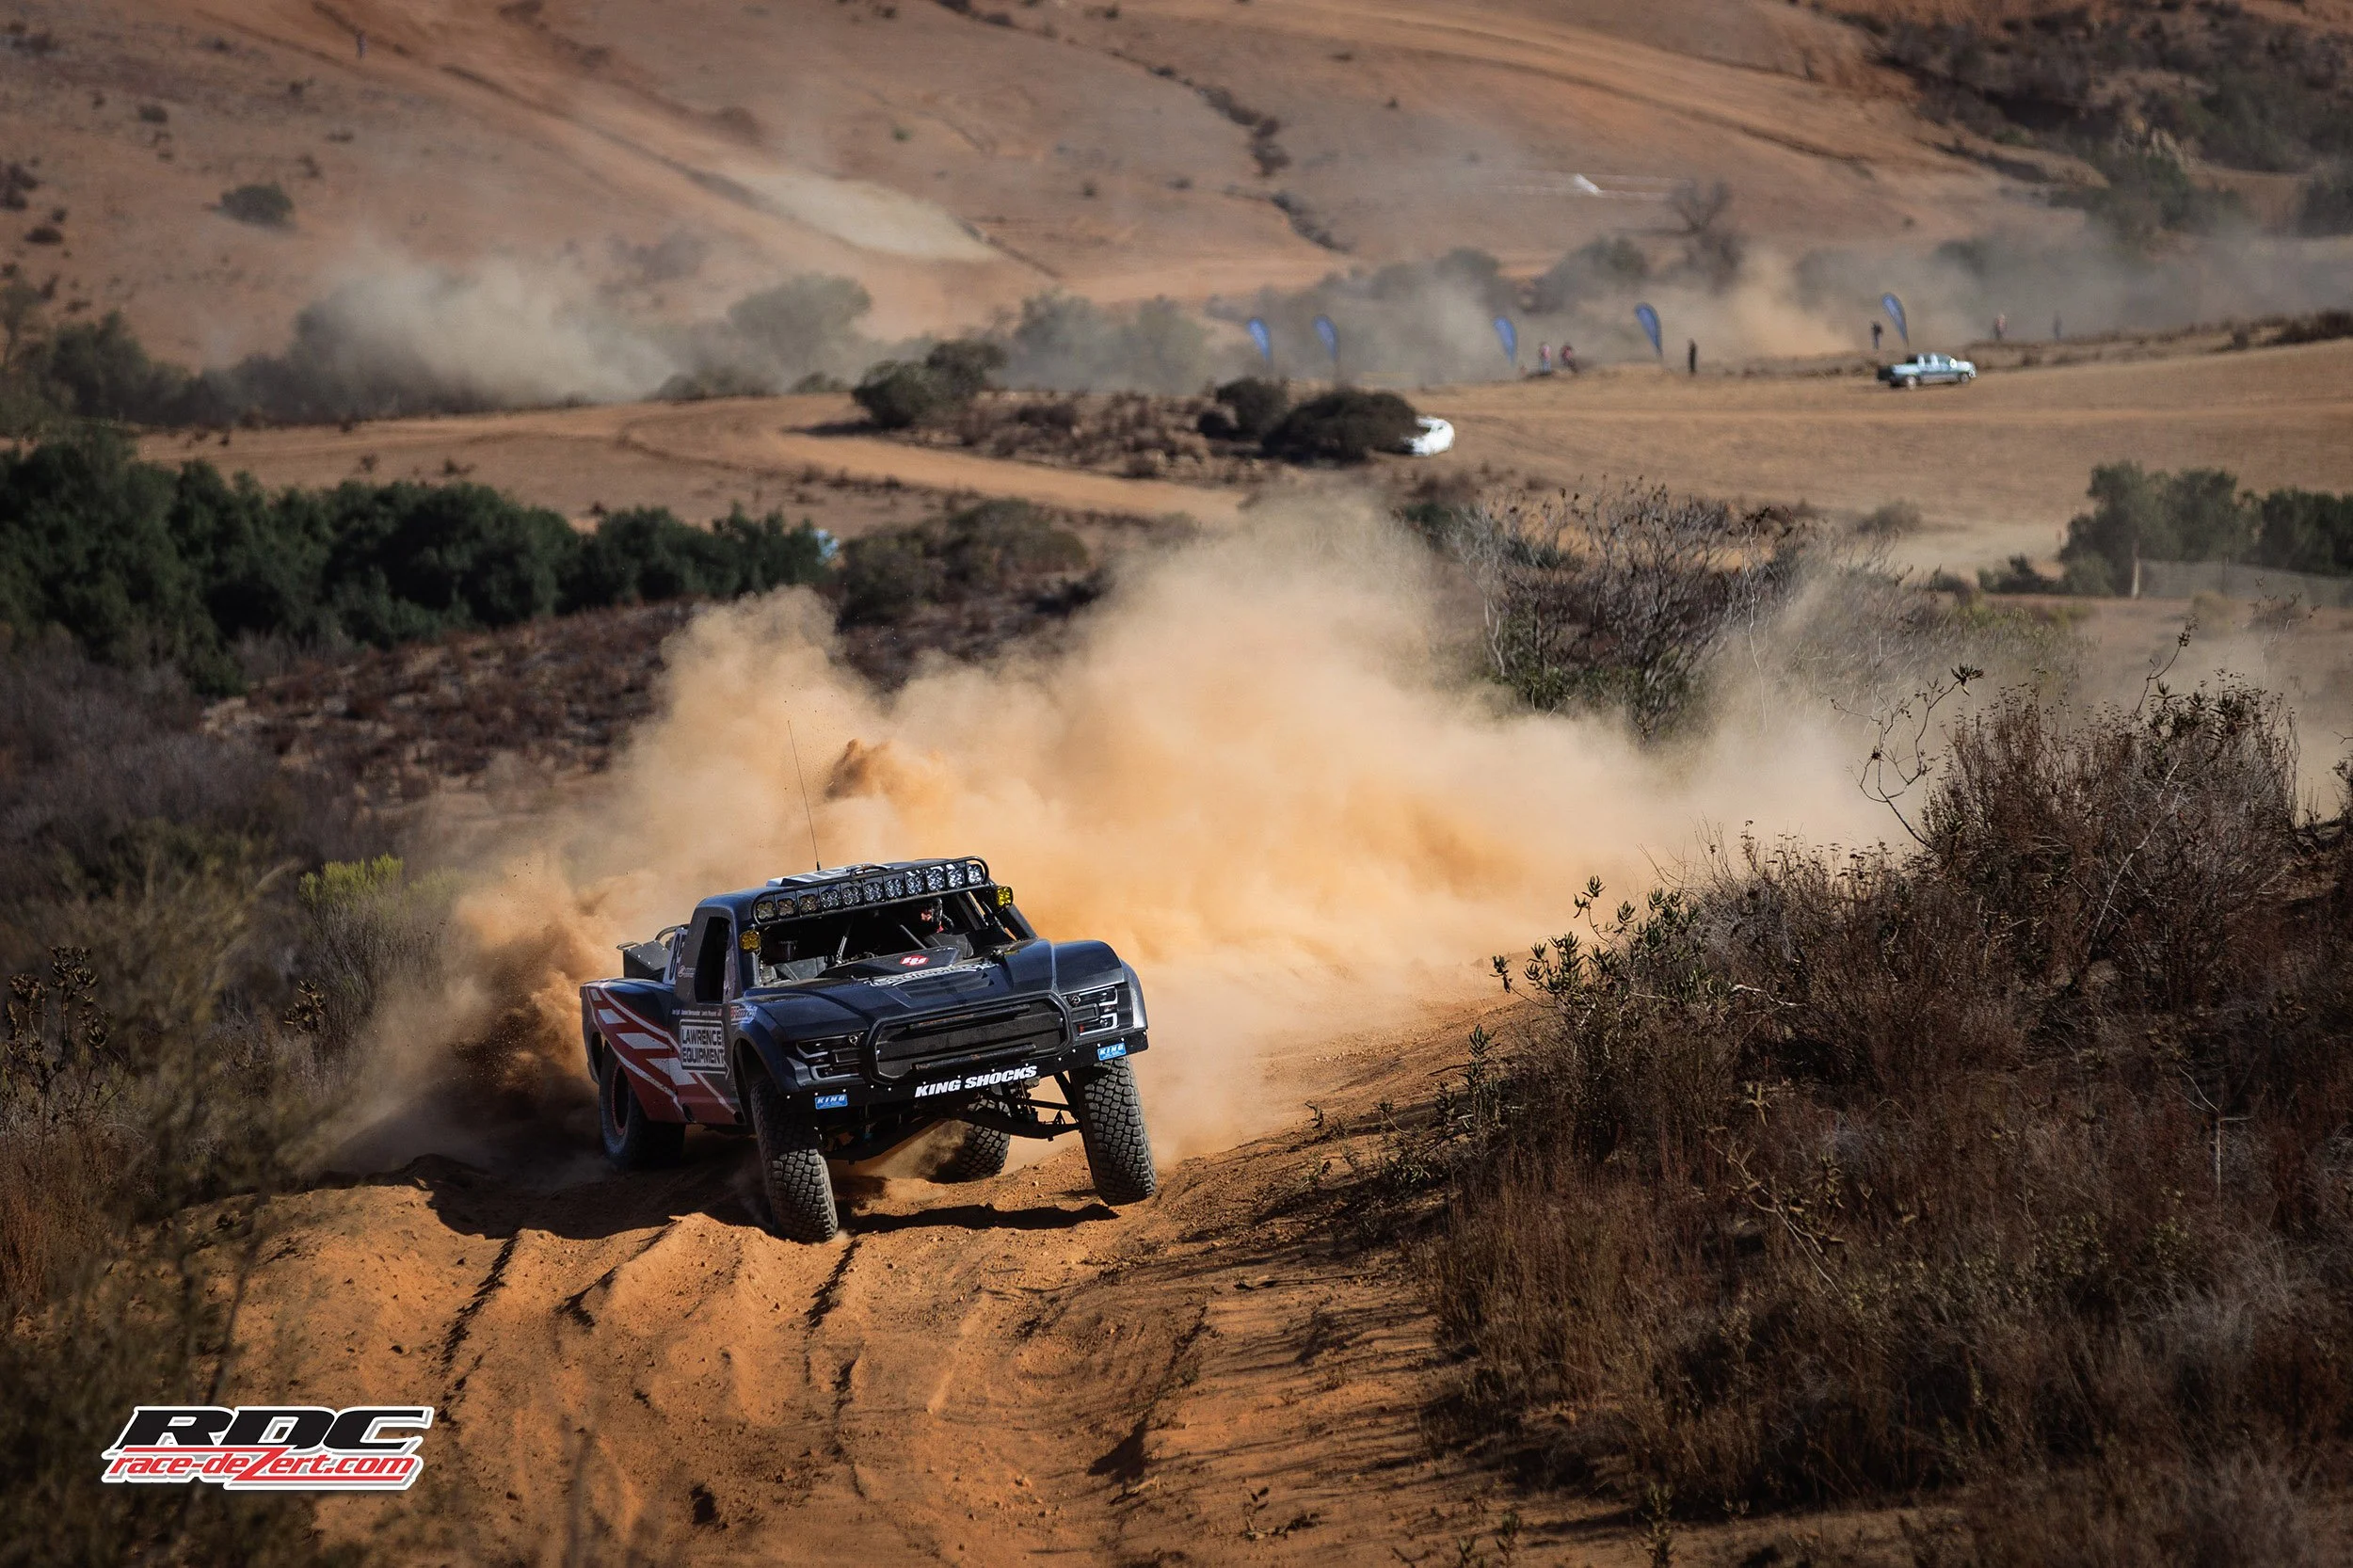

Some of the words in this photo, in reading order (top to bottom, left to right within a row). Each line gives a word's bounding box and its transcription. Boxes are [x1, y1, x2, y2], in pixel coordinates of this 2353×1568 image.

[681, 1029, 722, 1046] LAWRENCE
[682, 1047, 725, 1064] EQUIPMENT
[1099, 1044, 1124, 1055] KING
[915, 1080, 961, 1097] KING
[965, 1065, 1037, 1089] SHOCKS
[817, 1096, 845, 1104] KING
